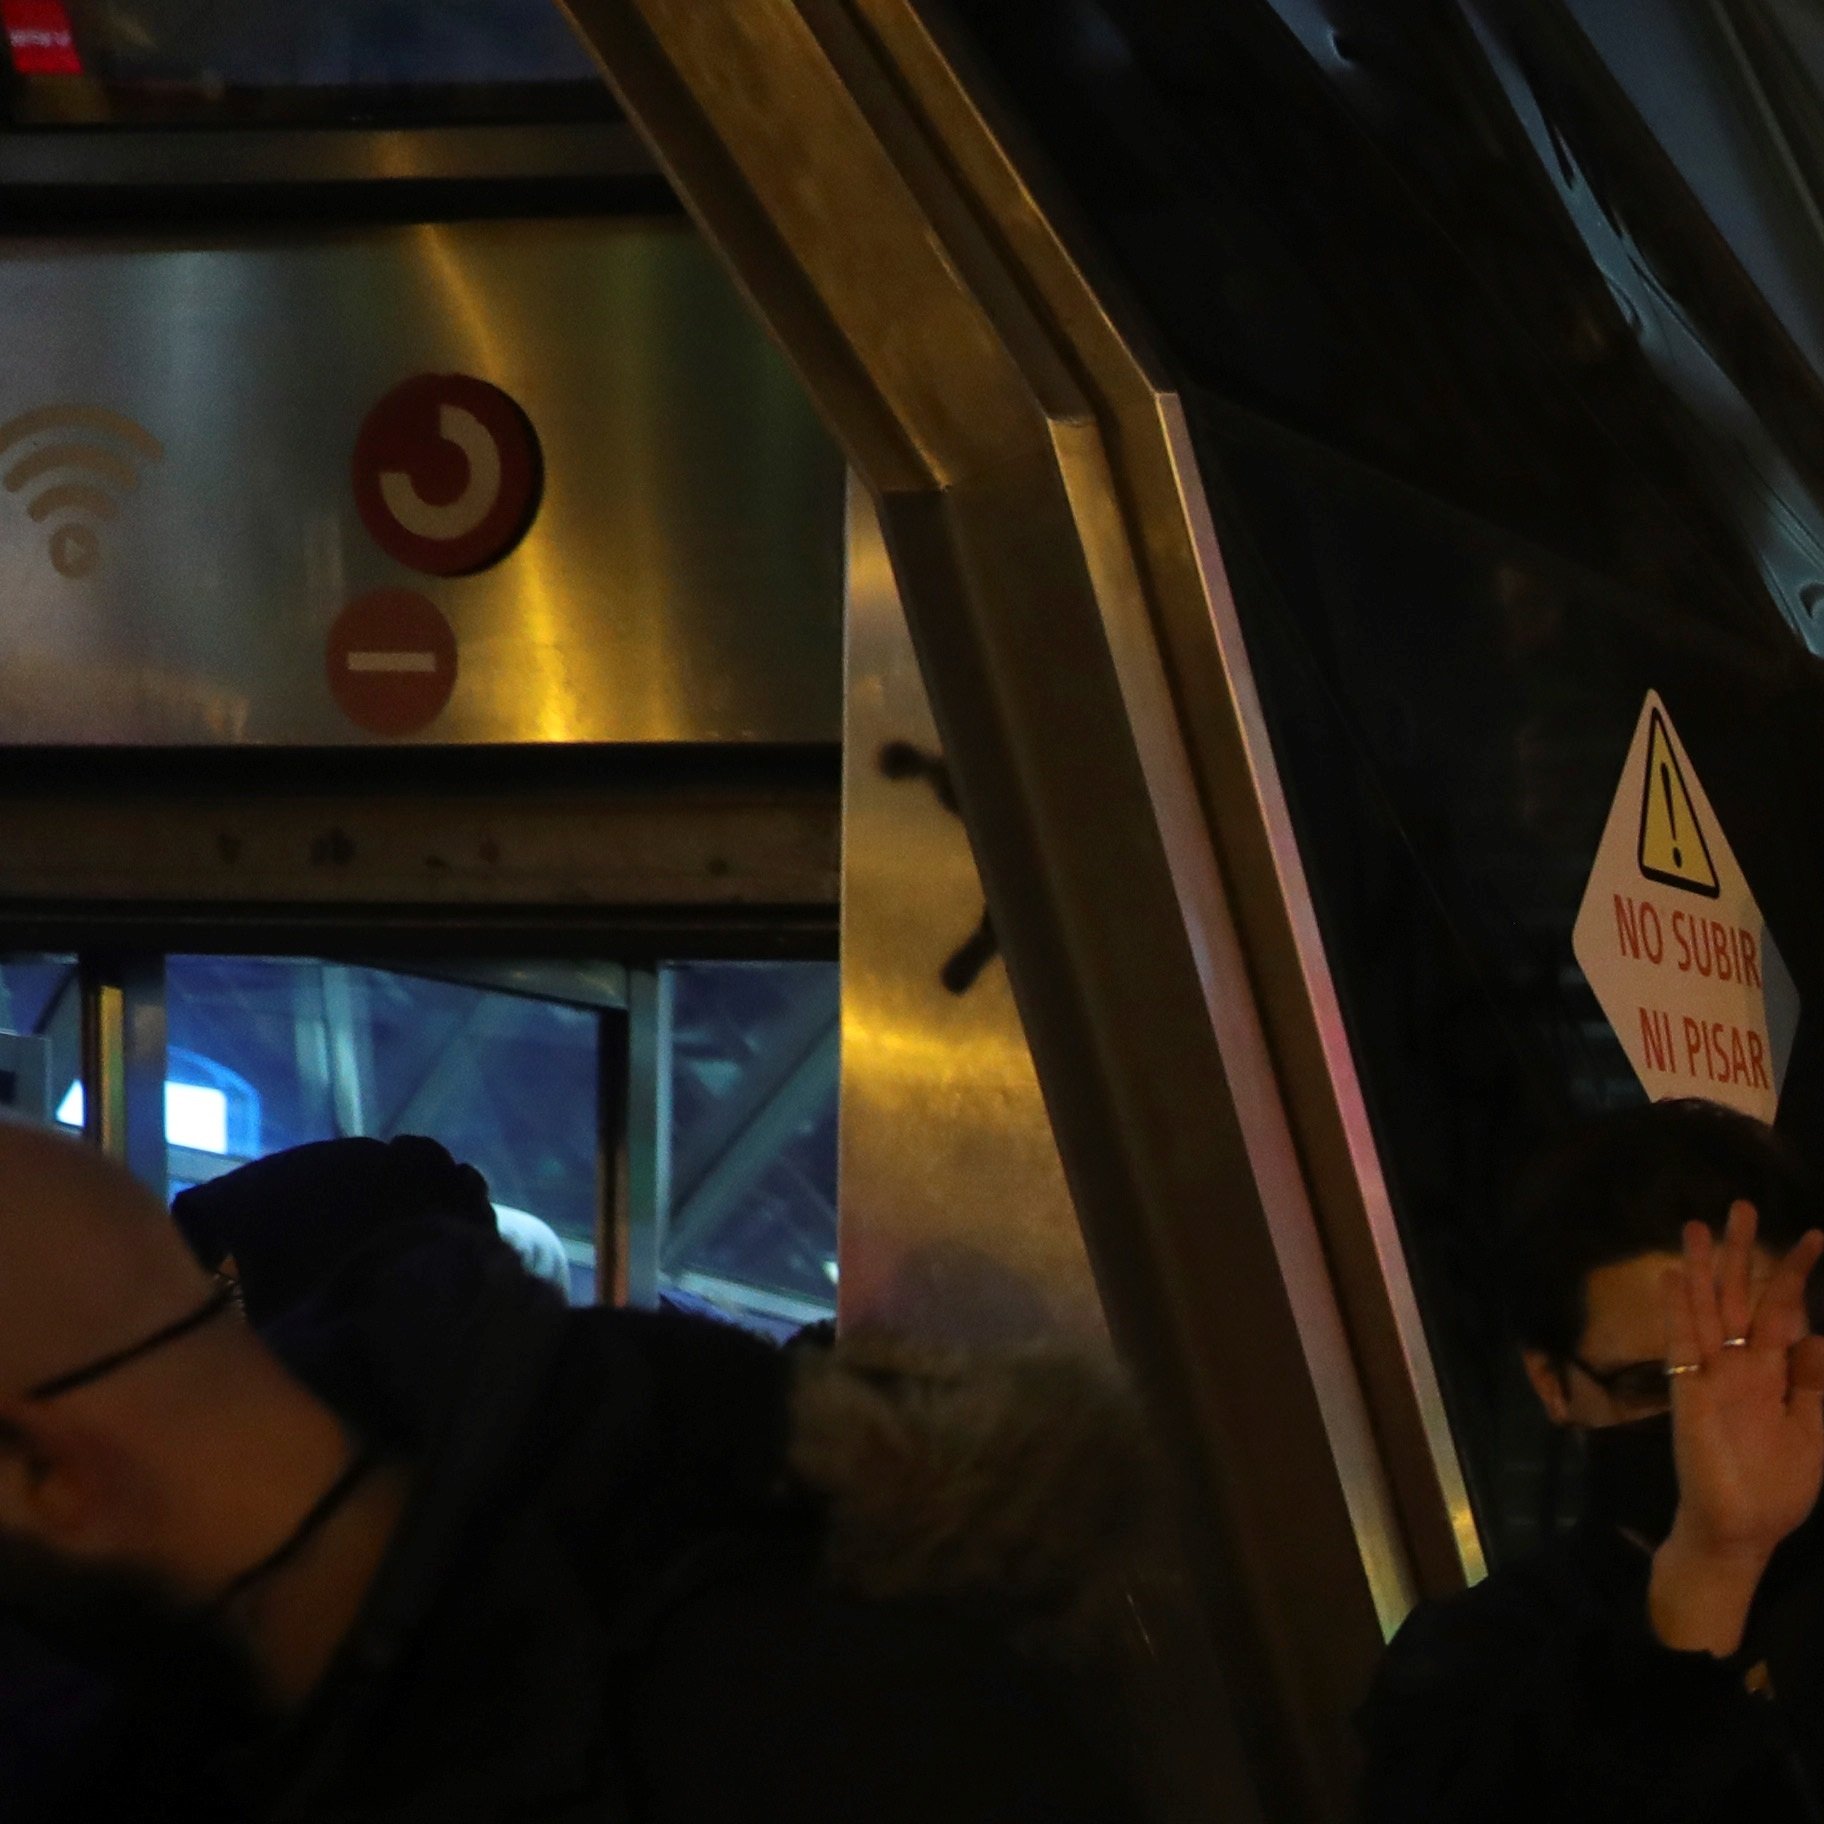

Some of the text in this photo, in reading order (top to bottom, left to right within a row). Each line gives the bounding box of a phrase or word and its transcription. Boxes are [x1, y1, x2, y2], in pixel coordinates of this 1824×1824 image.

[1613, 894, 1761, 989] NO SUBIR
[1638, 1006, 1769, 1090] NI PISAR
